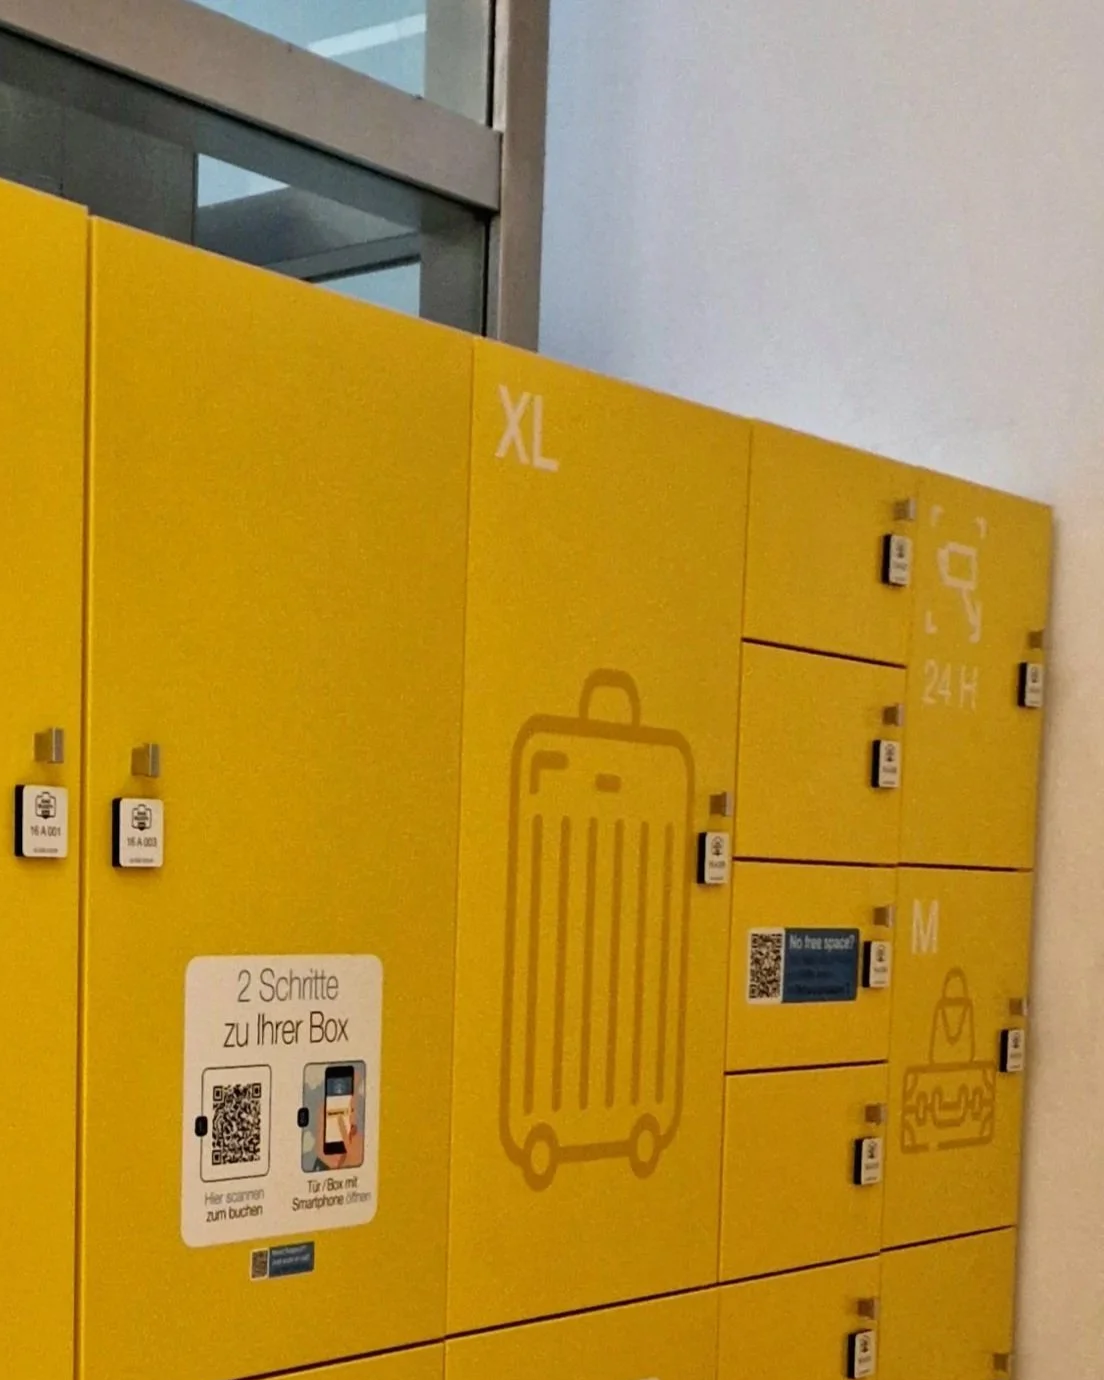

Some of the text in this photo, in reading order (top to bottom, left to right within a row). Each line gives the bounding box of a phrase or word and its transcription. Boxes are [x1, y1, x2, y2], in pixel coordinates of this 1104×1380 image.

[495, 384, 559, 472] XL
[923, 658, 979, 710] 24 H
[790, 934, 856, 952] No free space?
[911, 898, 940, 954] M
[237, 967, 339, 1003] 2 Schritte
[223, 1010, 349, 1048] zu Ihrer Box
[327, 1177, 343, 1191] Box
[345, 1175, 358, 1189] mit
[206, 1204, 264, 1223] zum buchen
[292, 1194, 344, 1212] Smartphone
